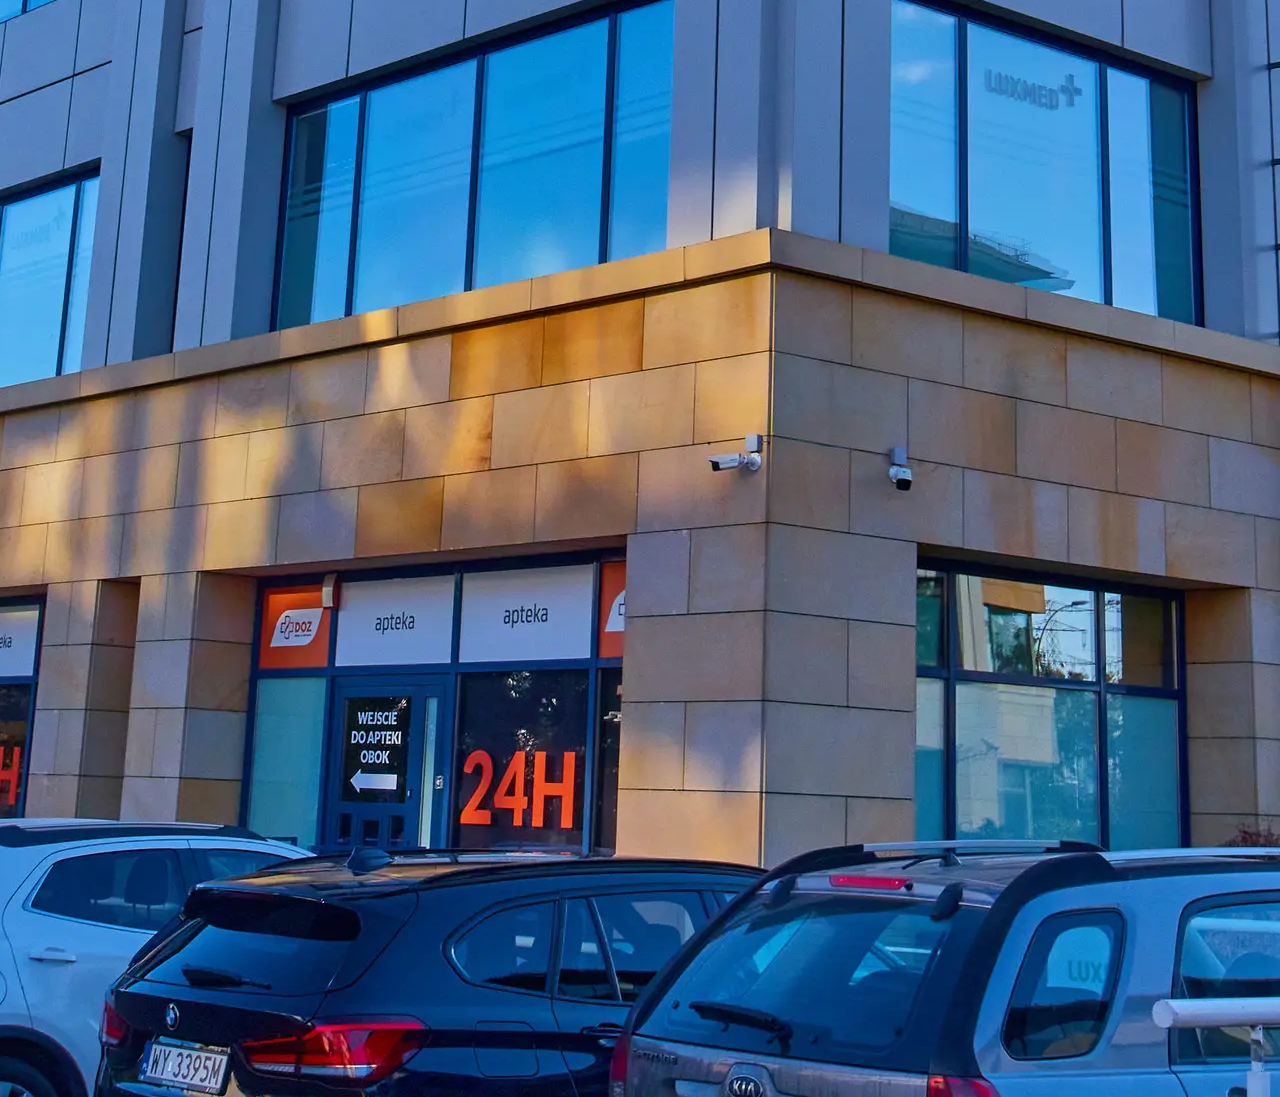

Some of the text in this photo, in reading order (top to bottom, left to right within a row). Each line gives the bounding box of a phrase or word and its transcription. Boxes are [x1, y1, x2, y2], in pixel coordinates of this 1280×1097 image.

[985, 69, 1060, 111] LUXMED
[294, 621, 313, 633] DOZ
[375, 611, 415, 635] apteka
[503, 604, 549, 629] apteka
[350, 730, 402, 745] DO APTEKI
[360, 750, 390, 764] OBOK
[459, 749, 576, 829] 24H
[150, 1047, 223, 1085] WY 3395M
[732, 1079, 756, 1096] KIA
